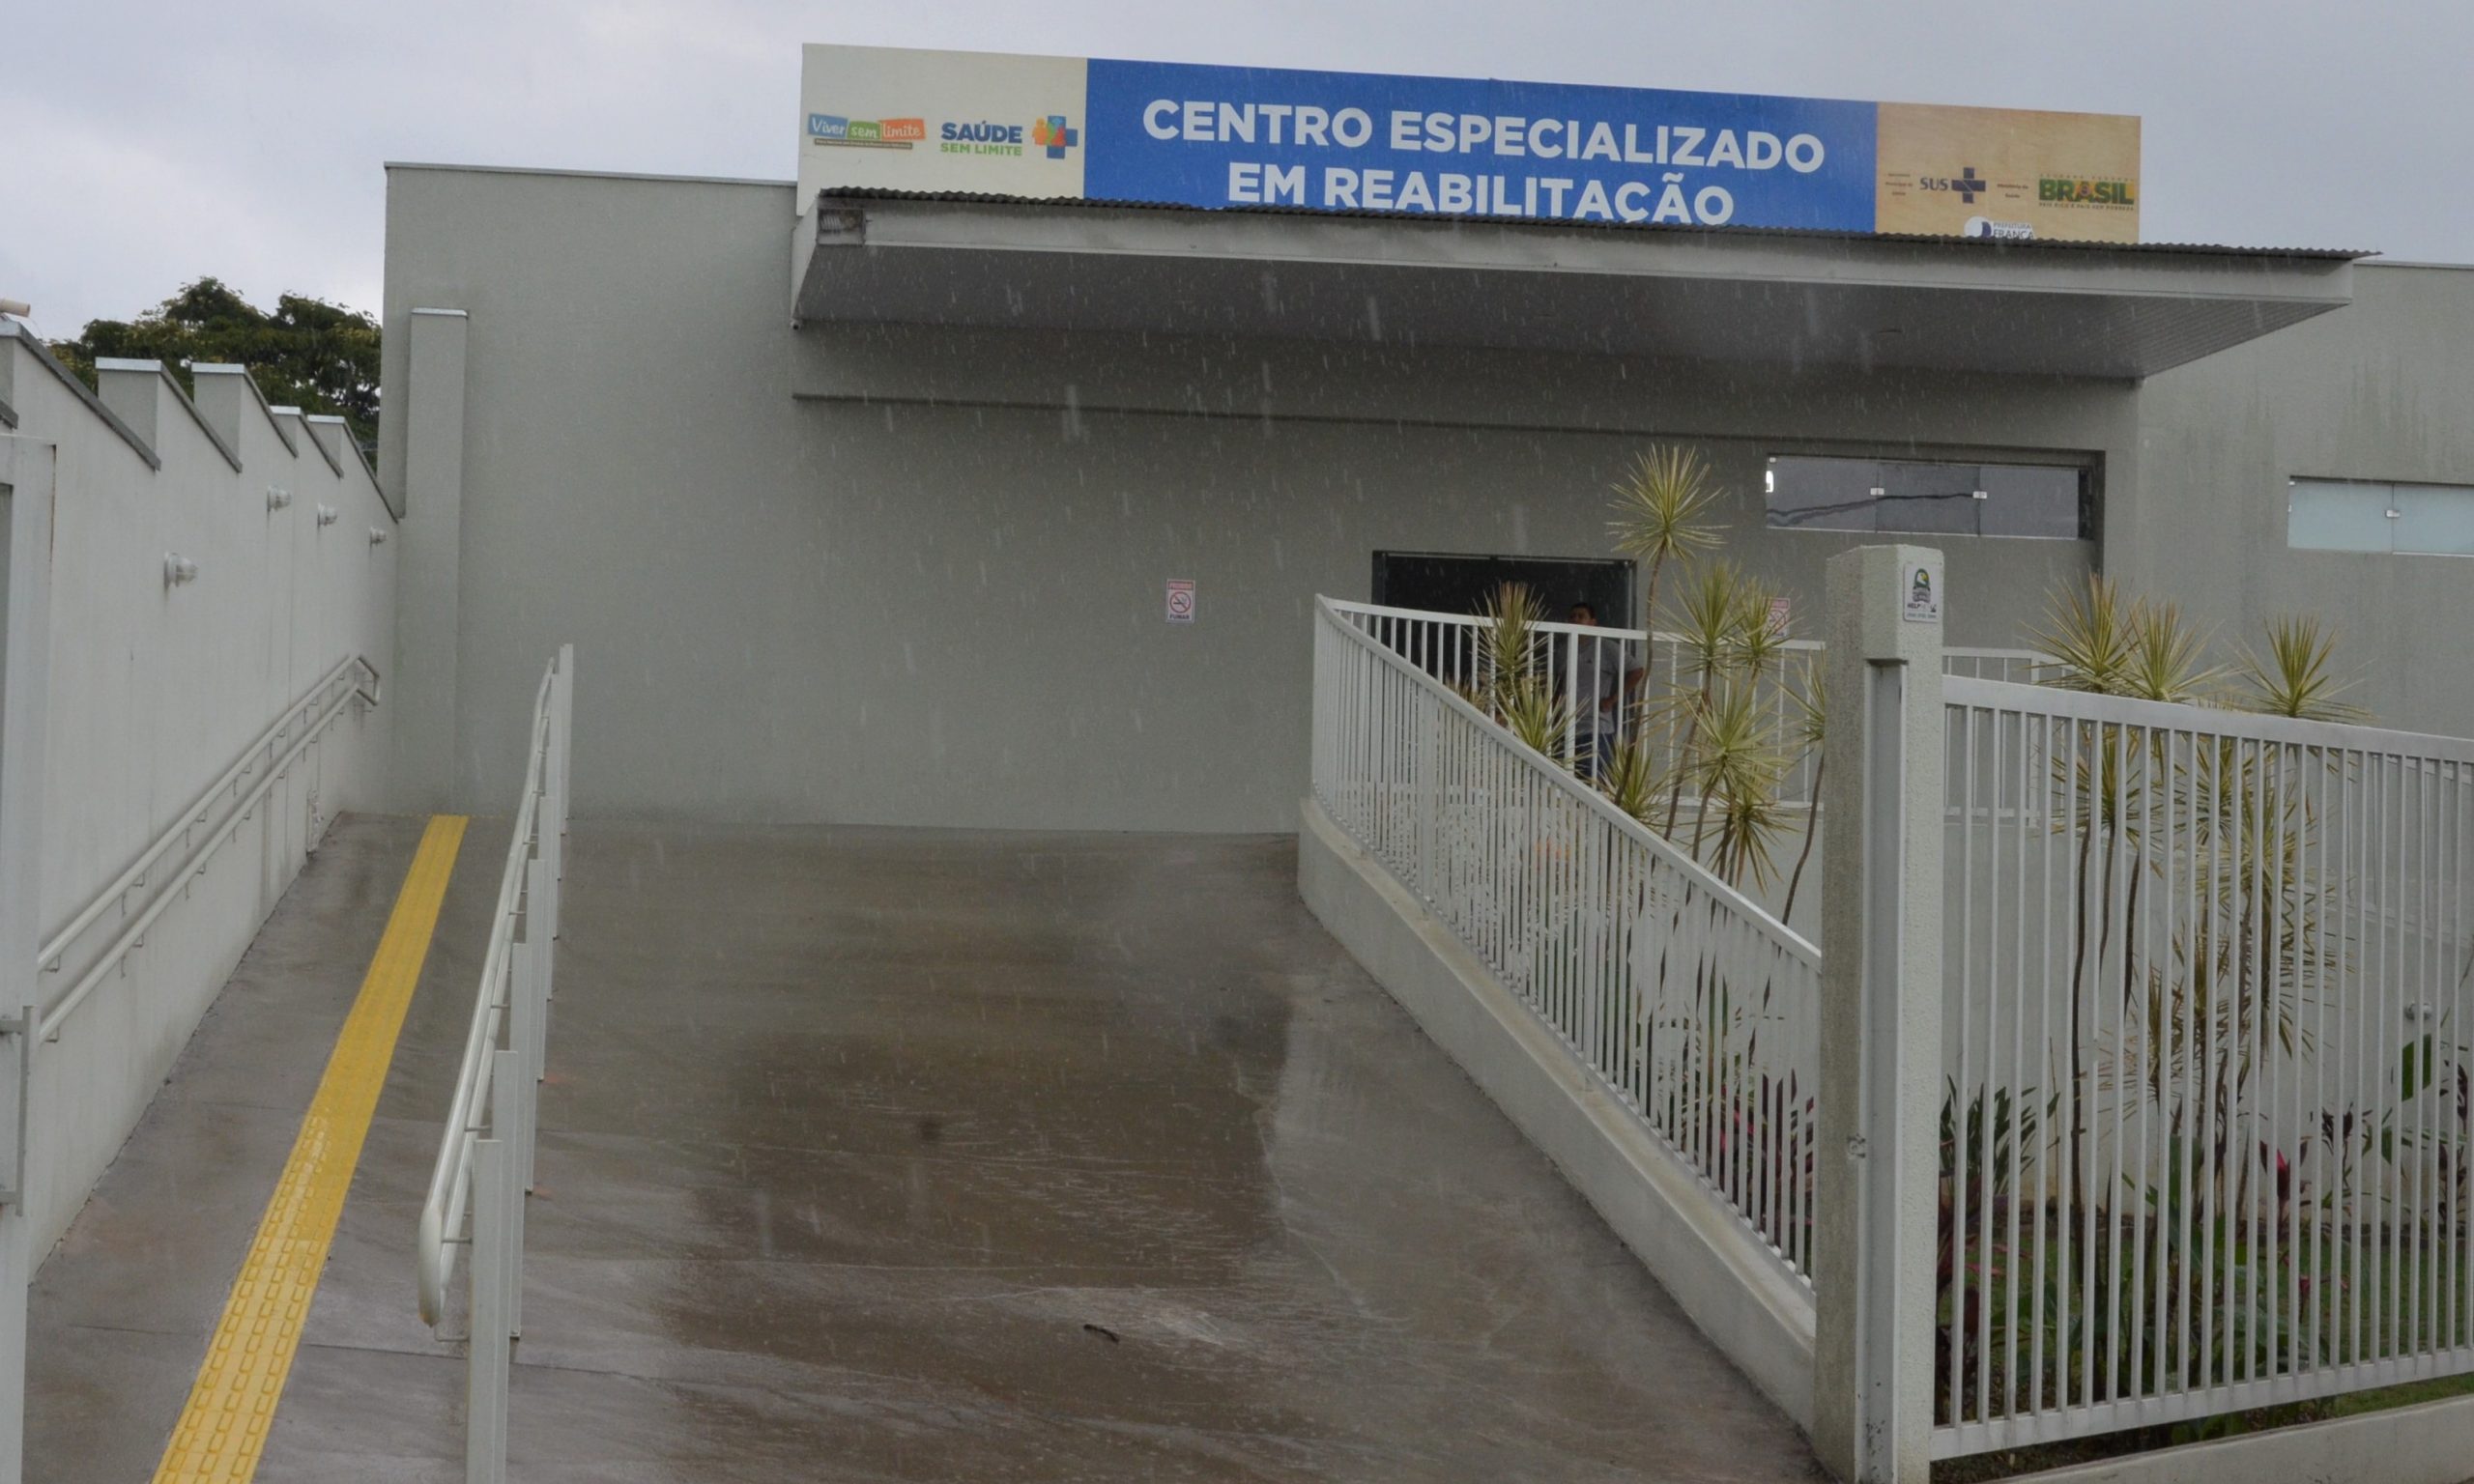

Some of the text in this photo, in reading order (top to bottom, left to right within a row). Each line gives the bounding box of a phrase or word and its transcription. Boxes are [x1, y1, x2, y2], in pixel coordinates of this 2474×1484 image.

[812, 116, 921, 139] Viver sem limite
[941, 120, 1022, 144] SAÚDE
[1142, 100, 1826, 173] CENTRO ESPECIALIZADO
[940, 142, 1022, 156] SEM LIMITE
[1228, 161, 1735, 226] EM REABILITAÇÃO
[1919, 177, 1948, 191] SUS
[2038, 178, 2135, 205] BRASIL
